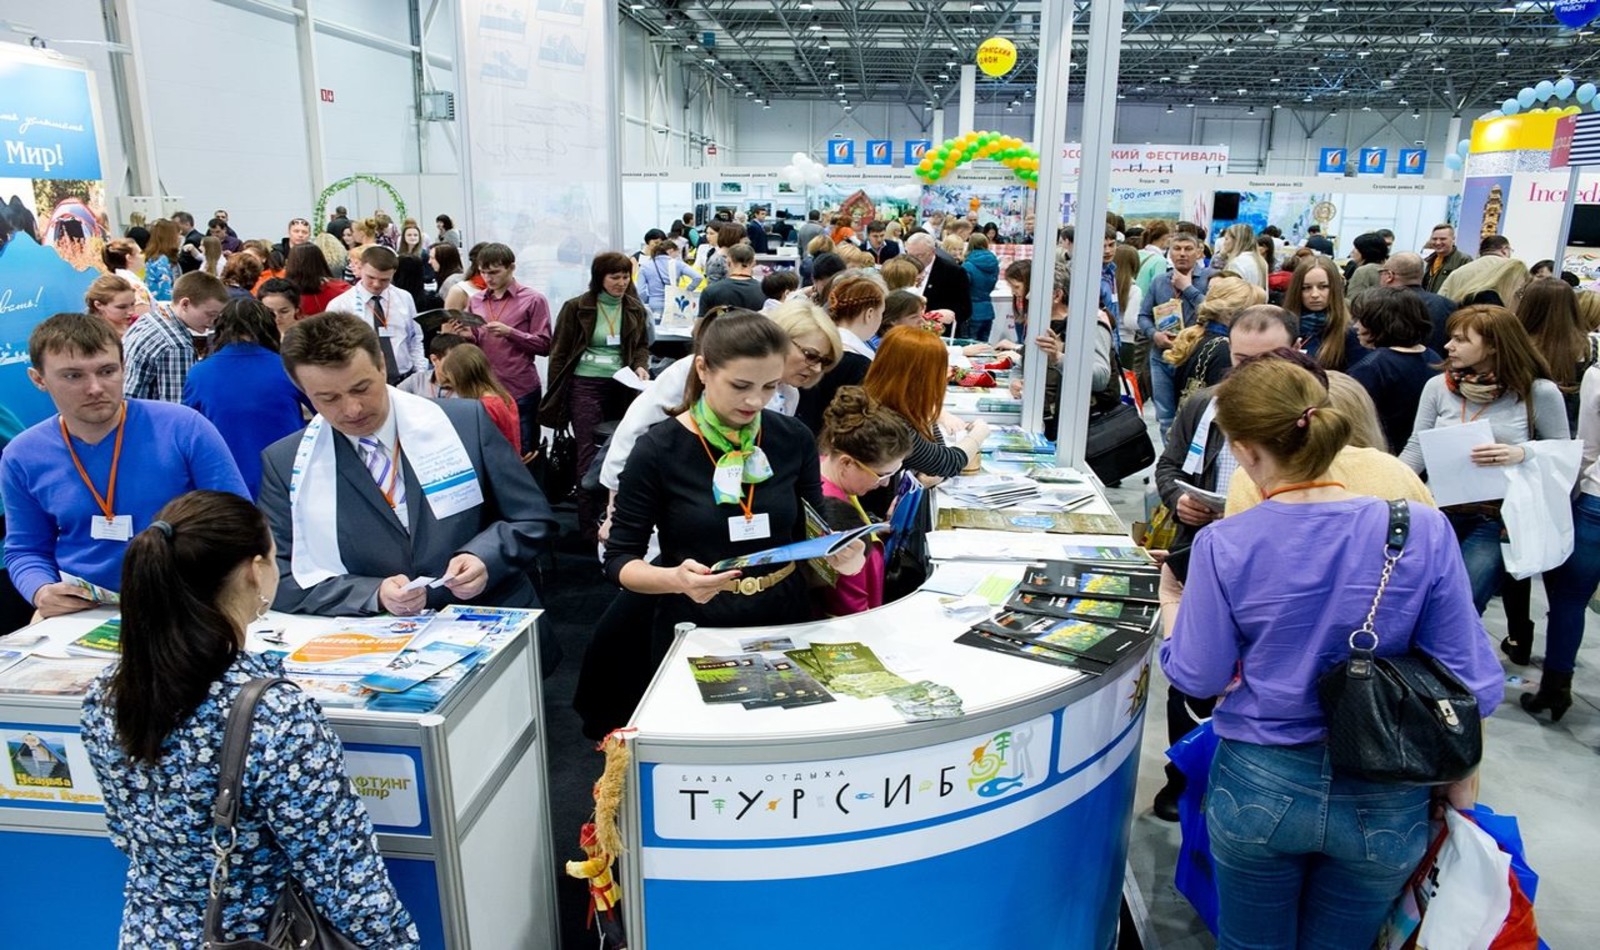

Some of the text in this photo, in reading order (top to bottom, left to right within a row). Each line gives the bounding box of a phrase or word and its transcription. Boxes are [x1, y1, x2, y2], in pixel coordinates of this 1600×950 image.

[4, 140, 64, 172] Мир!
[1145, 150, 1227, 162] ФЕСТИВАЛЬ
[681, 769, 846, 783] БАЗА ОТДЫХА
[349, 776, 412, 791] ФТИНГ
